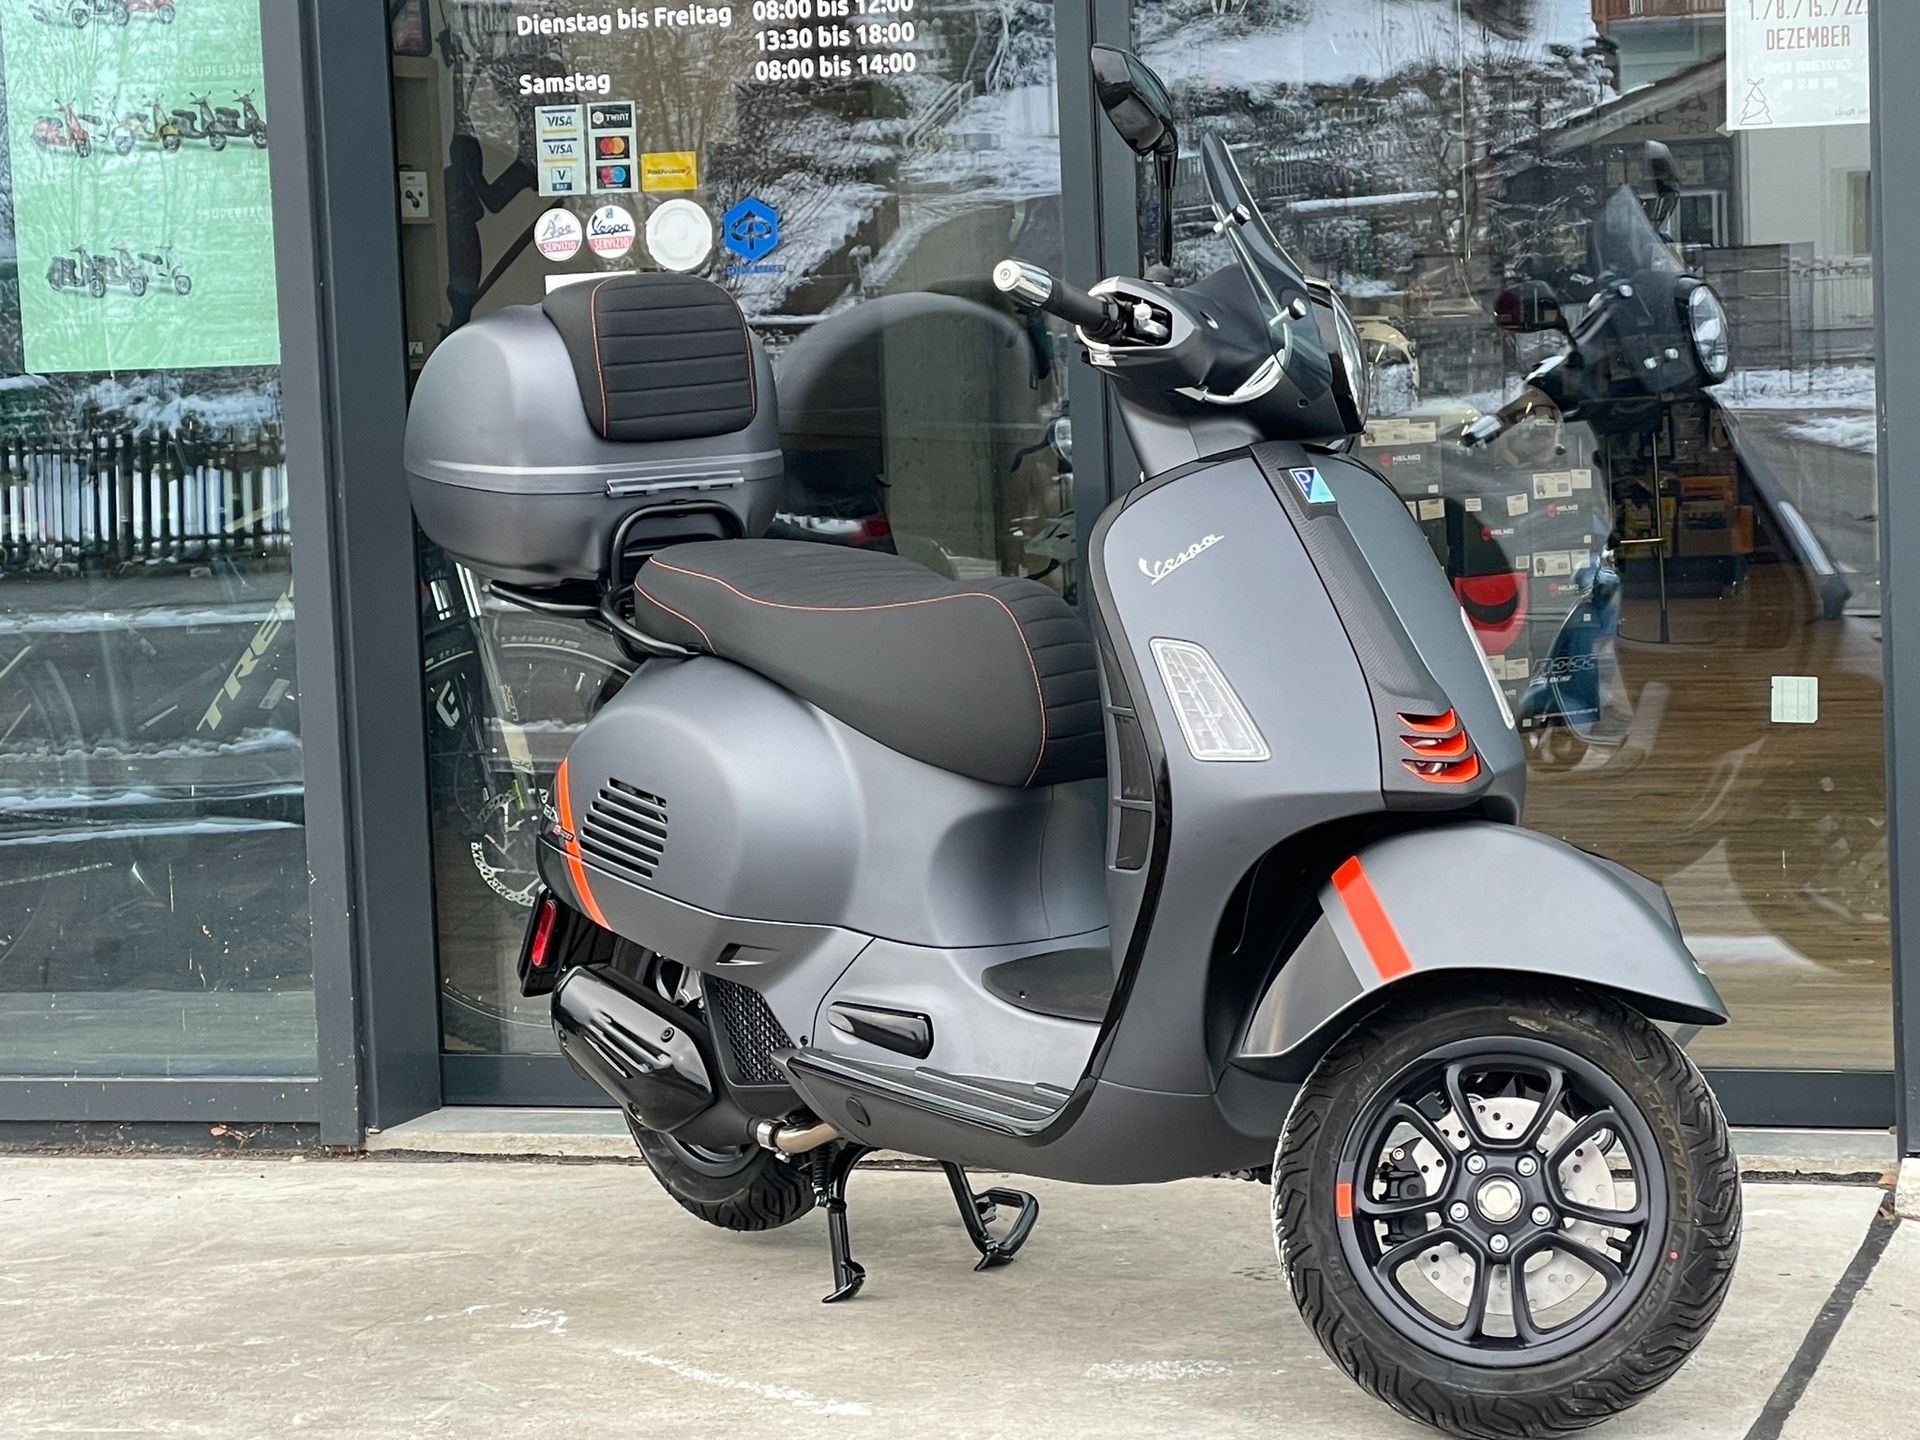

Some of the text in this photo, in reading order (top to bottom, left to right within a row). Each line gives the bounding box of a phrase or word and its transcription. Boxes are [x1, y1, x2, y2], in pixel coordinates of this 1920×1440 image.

[516, 4, 732, 36] Dienstag bis Freitag
[752, 0, 914, 21] 08:00 bis 12:00
[755, 21, 915, 51] 13:30 bis 18:00
[1766, 25, 1851, 51] DEZEMBER
[755, 52, 916, 81] 08:00 bis 14:00
[518, 72, 611, 95] Samstag
[547, 115, 573, 127] VISA
[606, 113, 630, 122] TWINT
[548, 143, 573, 155] VISA
[556, 169, 567, 181] V
[590, 214, 632, 236] Vespa
[543, 240, 577, 252] SERVIZIO
[593, 237, 630, 250] SERVIZIO
[1138, 533, 1225, 586] Vespa
[1623, 1233, 1683, 1334] MICHELN
